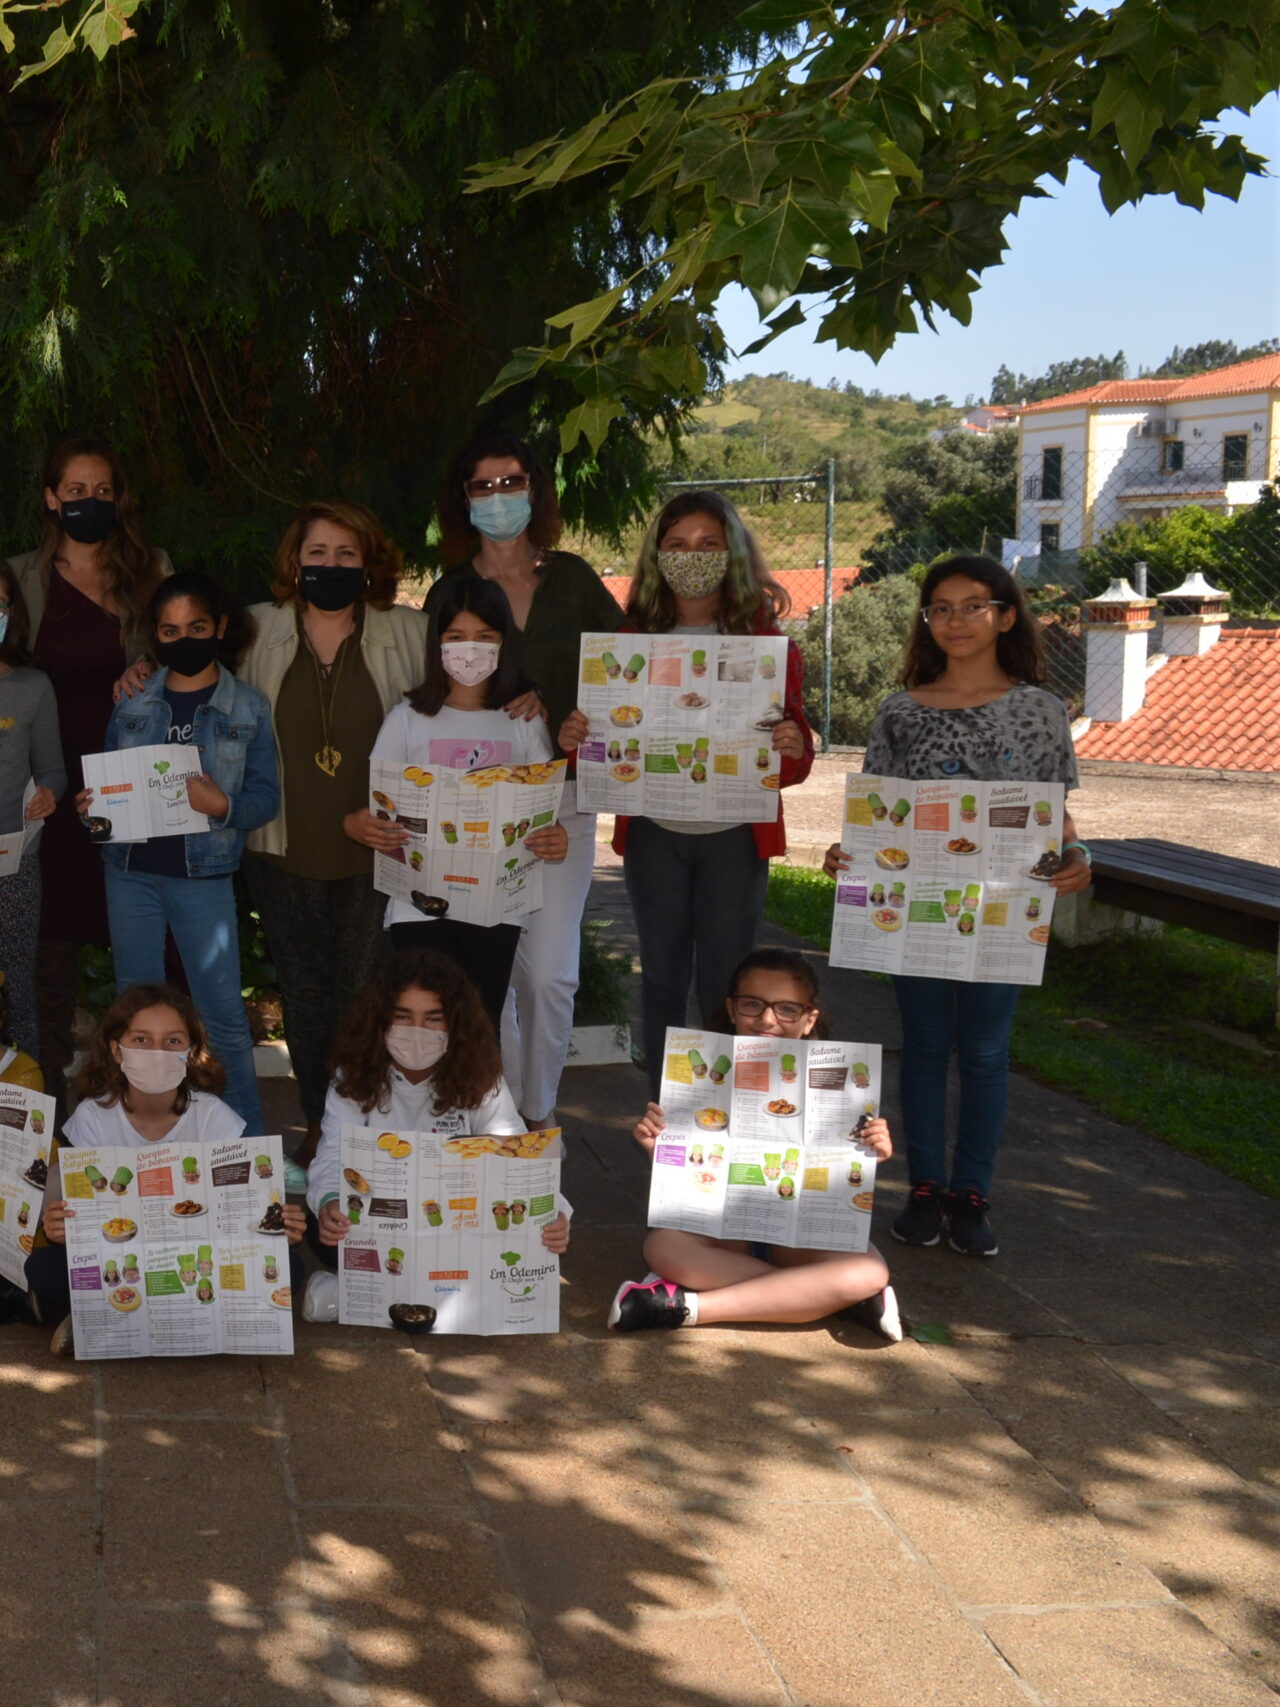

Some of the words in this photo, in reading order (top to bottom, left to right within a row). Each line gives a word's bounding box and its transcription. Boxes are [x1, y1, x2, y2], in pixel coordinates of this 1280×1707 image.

[149, 778, 161, 788] Em
[163, 770, 199, 783] Odemira
[496, 875, 508, 886] Em
[510, 857, 542, 878] Odemira
[842, 873, 867, 884] Crepes
[661, 1132, 686, 1143] Crepes
[137, 1147, 171, 1161] Queques
[211, 1143, 243, 1156] Salame
[148, 1154, 180, 1167] banana
[378, 1222, 408, 1232] Cookies
[344, 1238, 377, 1246] Granola
[72, 1253, 97, 1264] Crepes
[490, 1268, 506, 1280] Em
[510, 1264, 556, 1278] Odemira
[510, 1296, 536, 1304] Lanches
